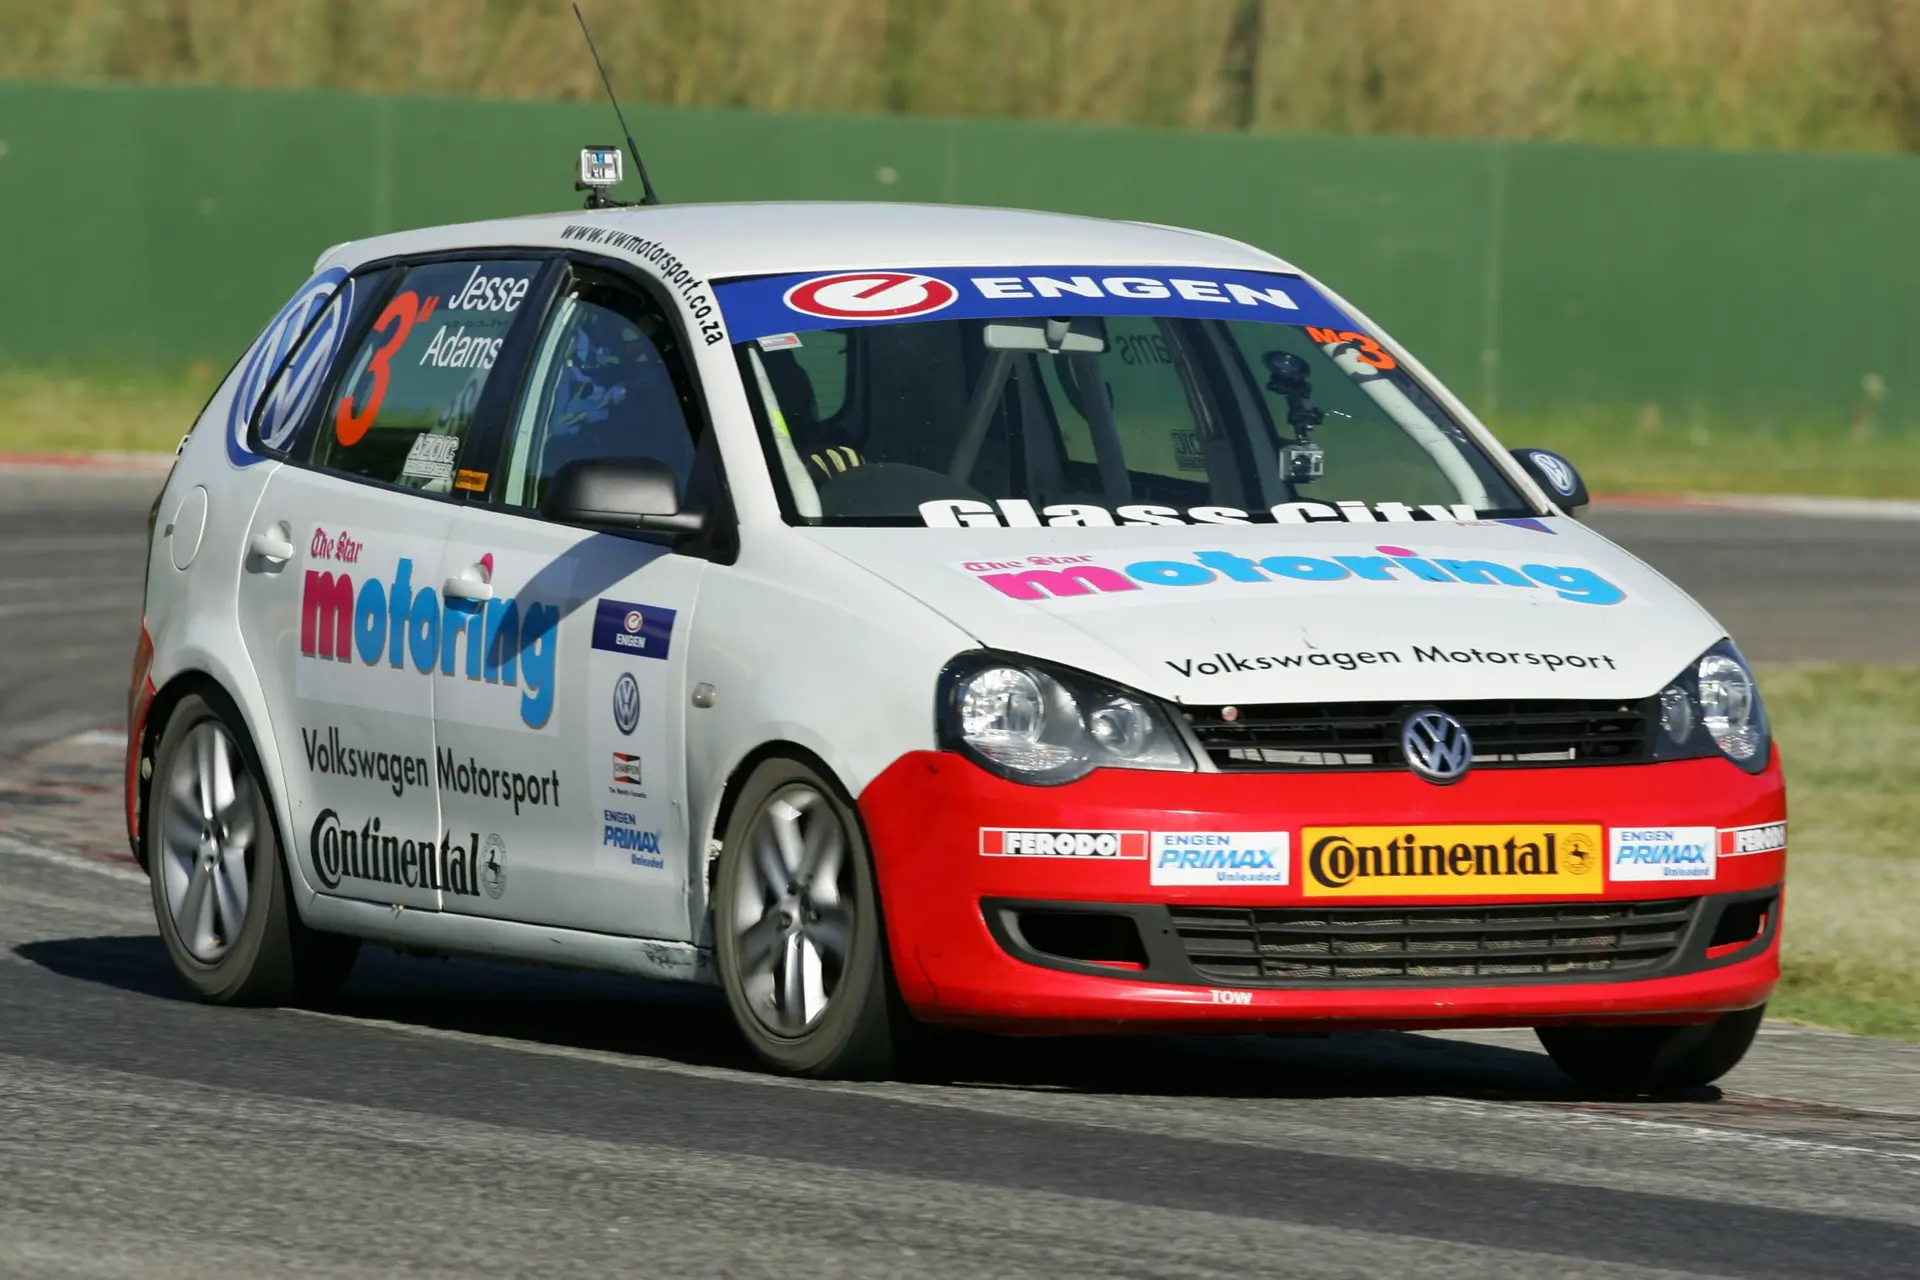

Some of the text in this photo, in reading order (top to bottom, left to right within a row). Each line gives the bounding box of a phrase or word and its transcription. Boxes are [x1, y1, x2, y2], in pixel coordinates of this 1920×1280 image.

[448, 265, 529, 312] Jesse
[560, 224, 724, 346] www.vwmotorsport.co.za
[969, 276, 1299, 310] ENGEN
[419, 325, 503, 369] Adams
[918, 498, 1252, 527] Glass
[311, 527, 363, 564] The Star
[960, 554, 1094, 572] The Star
[978, 545, 1627, 605] motoring
[301, 553, 560, 729] motoring
[616, 633, 646, 649] ENGEN
[1165, 645, 1618, 679] Volkswagen Motorsport
[301, 726, 560, 815] Volkswagen Motorsport
[604, 809, 636, 825] ENGEN
[603, 825, 661, 854] PRIMAX
[1005, 832, 1118, 856] FERODO
[1164, 835, 1229, 847] ENGEN
[1621, 831, 1674, 842] ENGEN
[310, 808, 480, 897] Continental
[1157, 848, 1277, 870] PRIMAX
[1309, 833, 1559, 888] Continental
[1616, 844, 1707, 864] PRIMAX
[1217, 871, 1281, 883] Unleaded
[1210, 990, 1253, 1006] TOW
